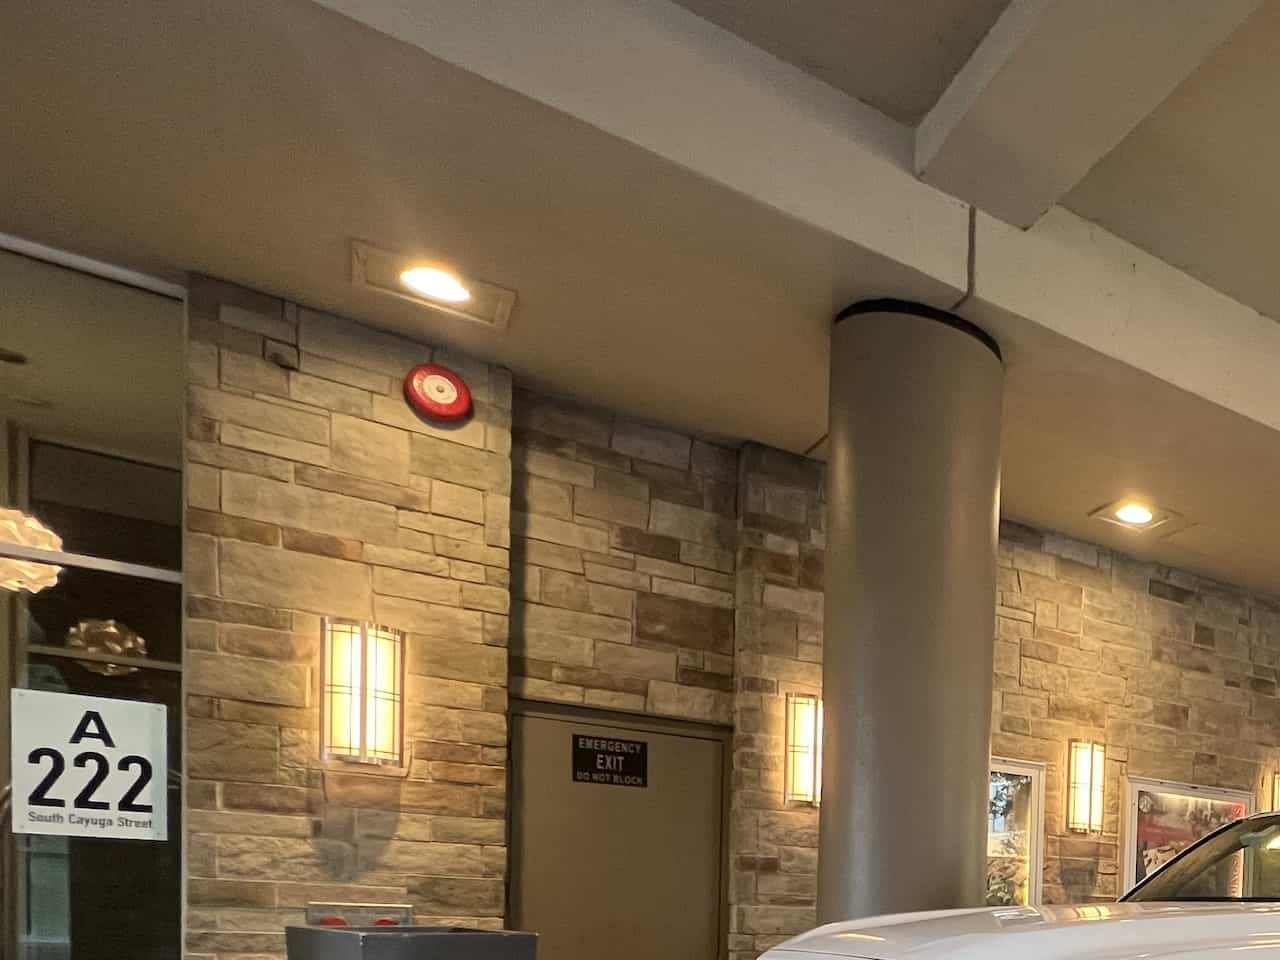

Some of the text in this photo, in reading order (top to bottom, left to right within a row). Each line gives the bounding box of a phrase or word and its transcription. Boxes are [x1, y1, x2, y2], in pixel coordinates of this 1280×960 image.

[69, 710, 116, 748] A
[578, 738, 642, 754] EMERGENCY
[596, 754, 625, 773] EXIT
[28, 747, 153, 814] 222
[28, 811, 153, 829] South Cayuga Street
